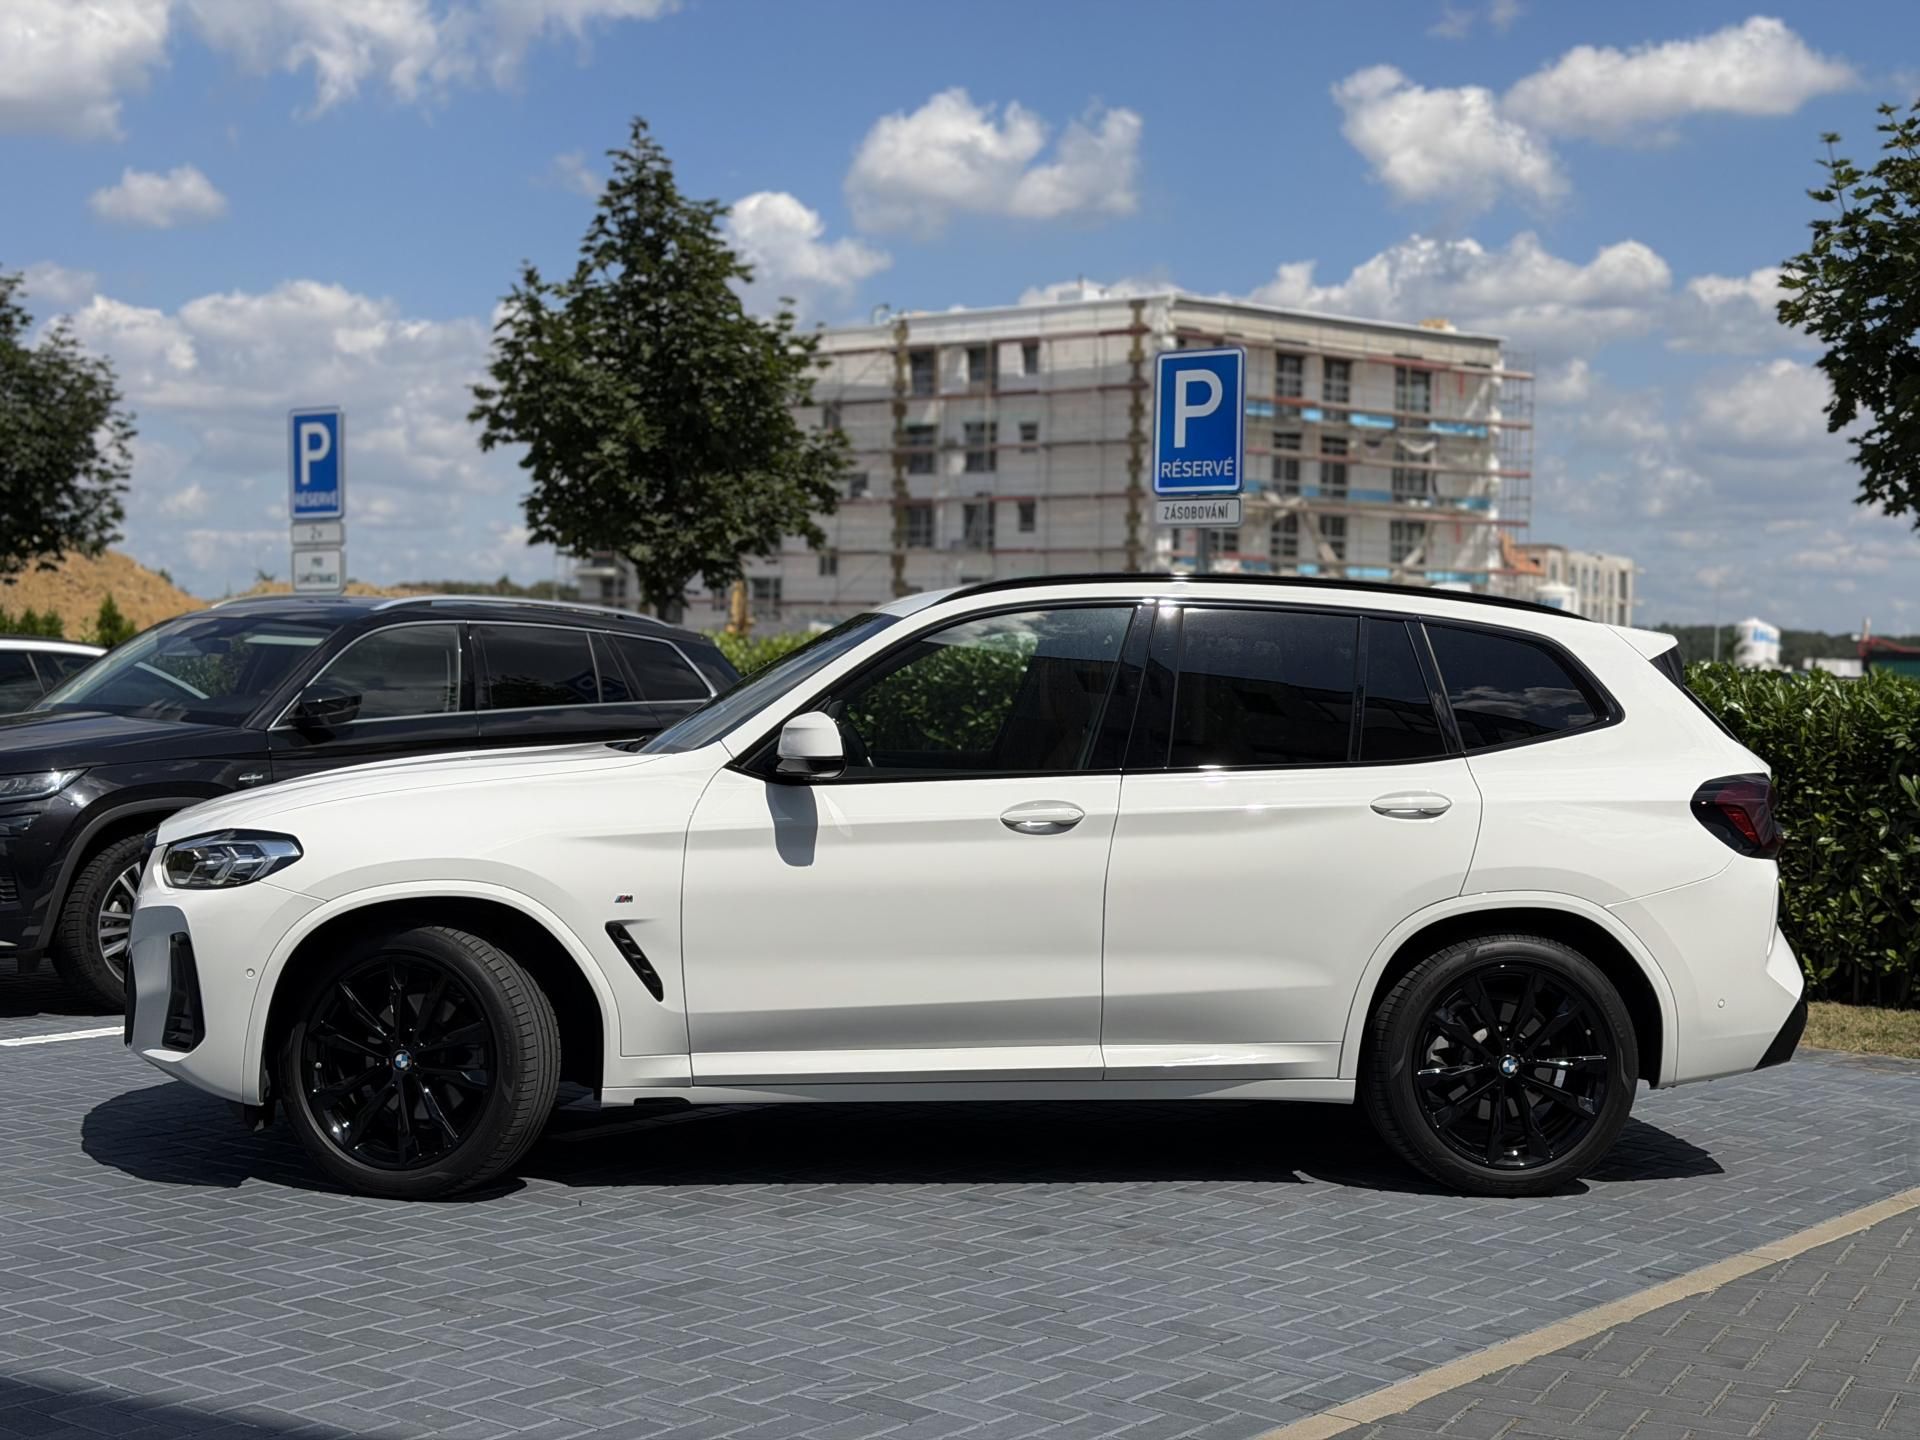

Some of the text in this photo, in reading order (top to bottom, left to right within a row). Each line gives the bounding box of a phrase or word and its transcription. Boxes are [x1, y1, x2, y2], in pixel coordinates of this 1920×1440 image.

[1174, 369, 1223, 449] P
[300, 422, 331, 485] P
[1161, 456, 1234, 478] RÉSERVÉ
[1164, 502, 1230, 520] ZÁSOBOVÁNÍ
